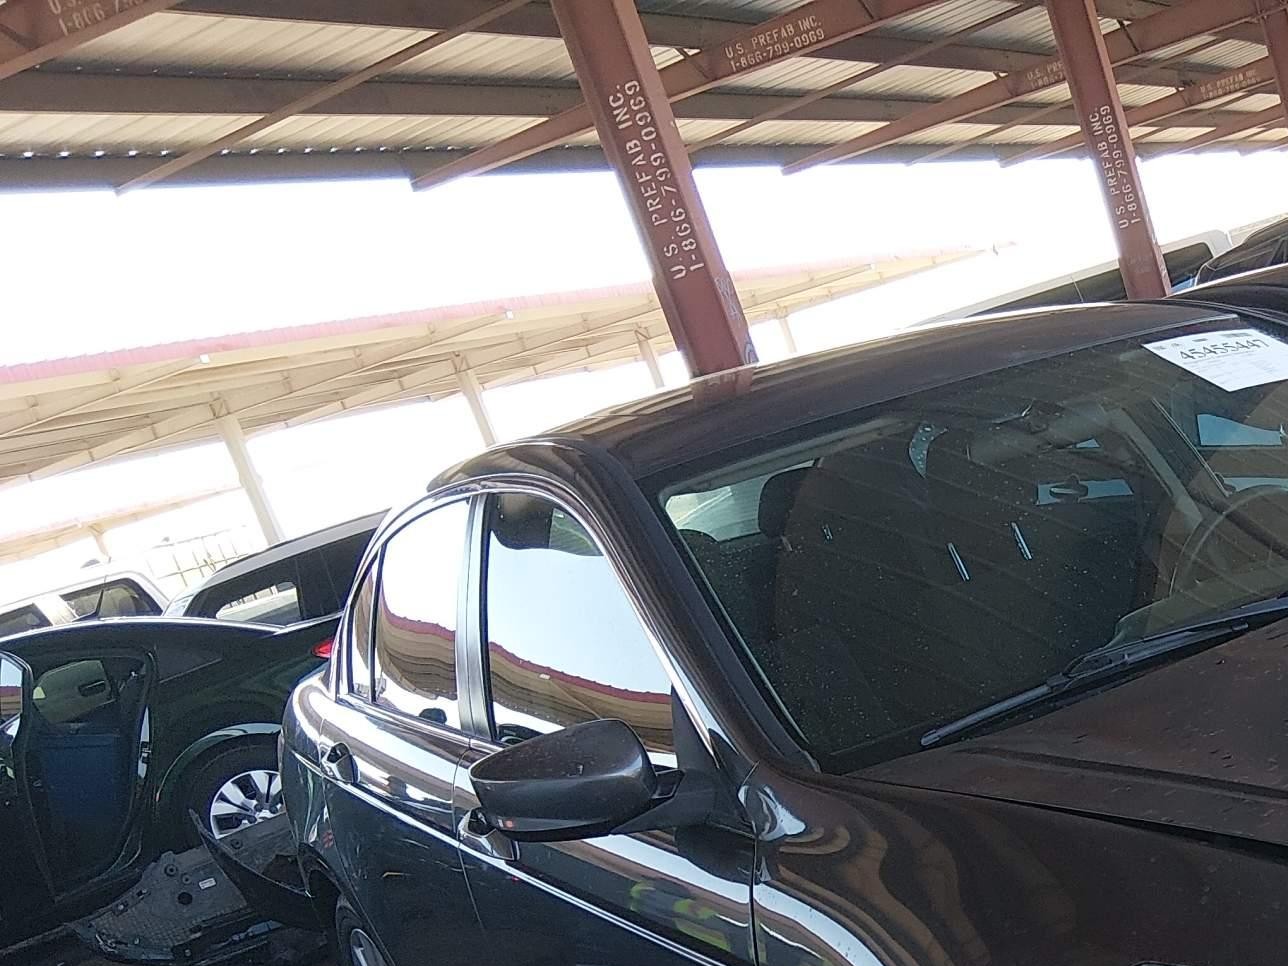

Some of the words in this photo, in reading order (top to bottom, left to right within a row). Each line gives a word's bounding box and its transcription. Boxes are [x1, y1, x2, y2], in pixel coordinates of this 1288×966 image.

[725, 43, 746, 59] U.S.
[751, 25, 796, 48] PREFAB
[798, 16, 822, 30] INC.
[608, 85, 633, 130] INC.
[1089, 108, 1104, 136] INC.
[624, 80, 705, 272] 1-866-799-0969
[626, 139, 668, 226] PREFAB
[1097, 142, 1120, 195] PREFAB
[1100, 105, 1141, 224] 1-866-799-0969
[663, 236, 687, 280] U.S.
[1180, 339, 1269, 360] 45455447
